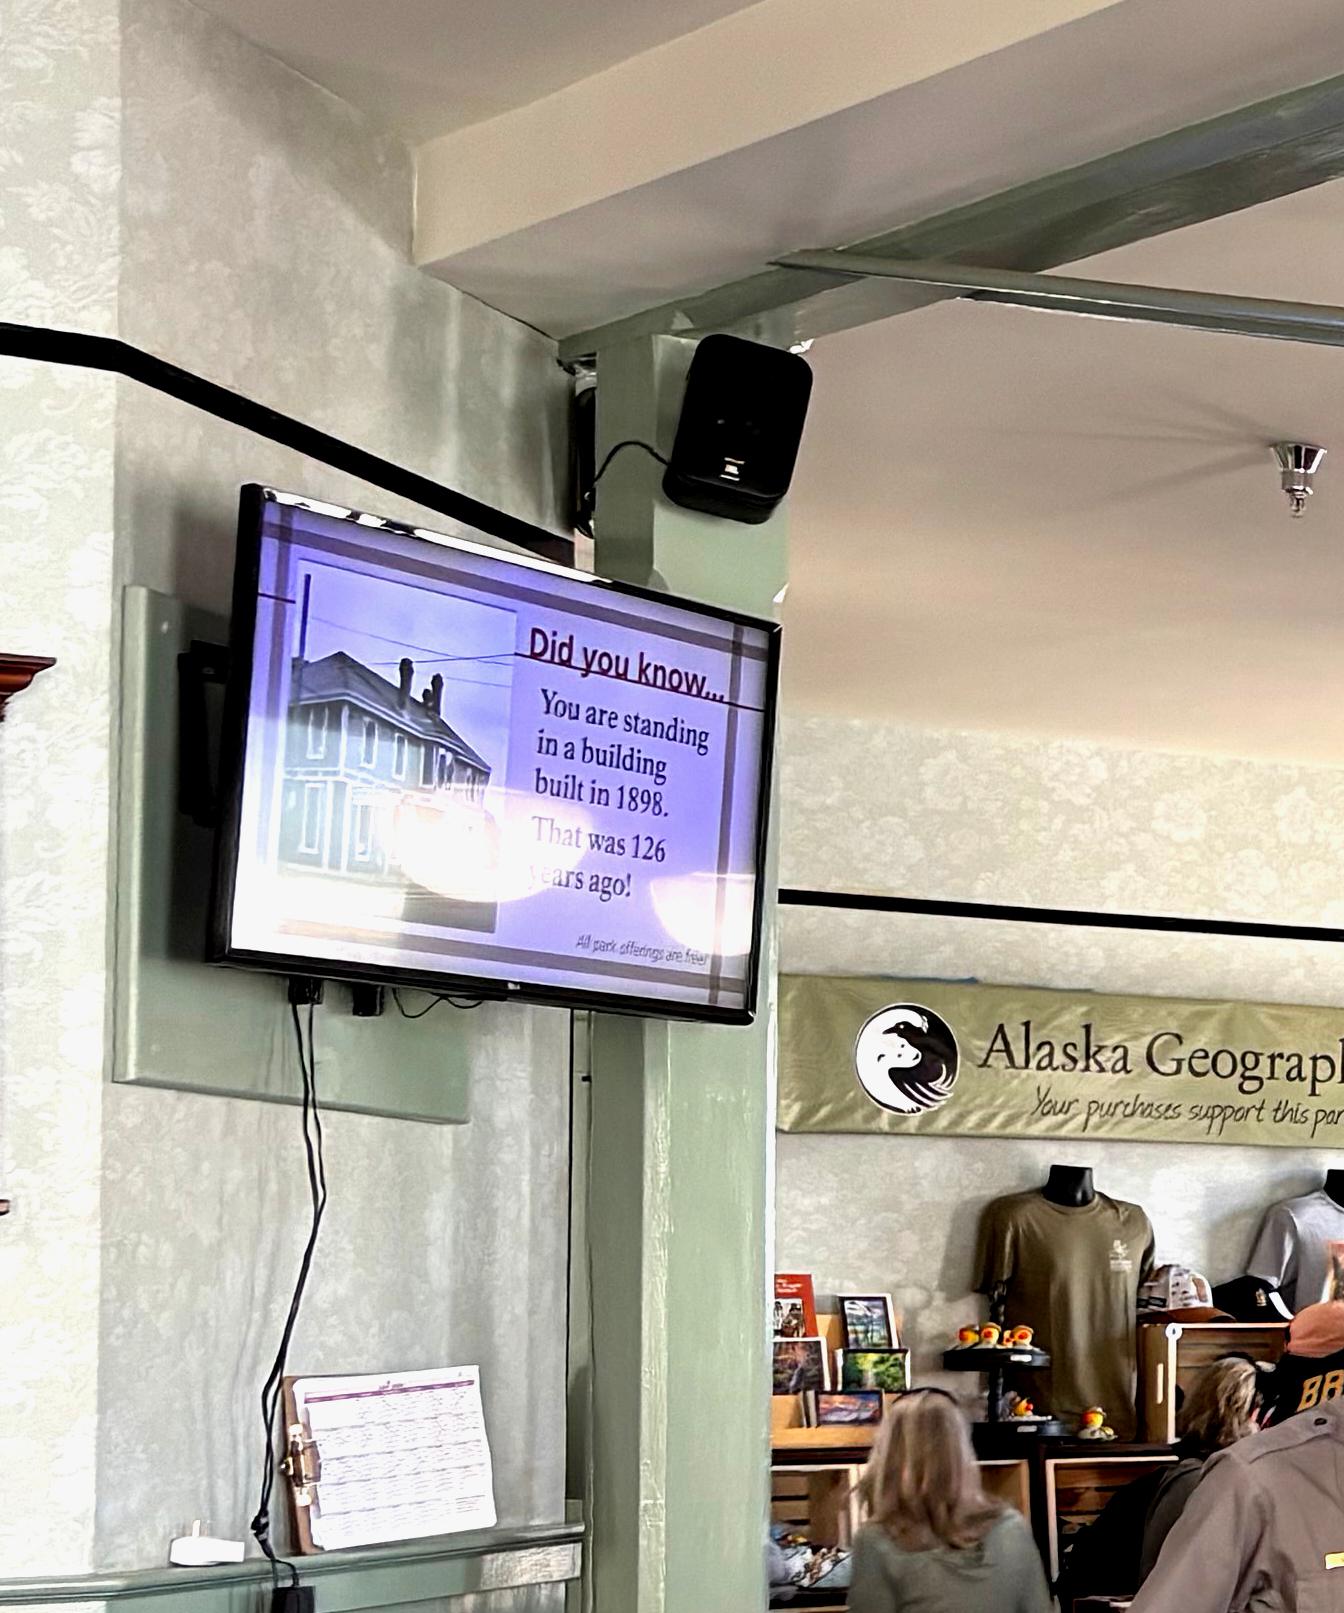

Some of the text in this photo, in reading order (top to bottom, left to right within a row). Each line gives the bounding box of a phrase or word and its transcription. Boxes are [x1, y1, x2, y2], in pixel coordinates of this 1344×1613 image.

[530, 627, 724, 703] Did you know...
[541, 688, 710, 757] You are standing
[537, 728, 667, 786] in a building
[535, 767, 669, 817] built in 1898.
[532, 815, 666, 863] That was 126
[588, 873, 632, 902] ago!
[592, 939, 616, 954] park
[619, 940, 665, 963] offerings
[665, 951, 683, 962] are
[977, 1020, 1132, 1075] Alaska
[1031, 1085, 1078, 1119] Your
[1082, 1093, 1182, 1132] purchases
[1188, 1097, 1264, 1137] support
[1272, 1098, 1308, 1126] this
